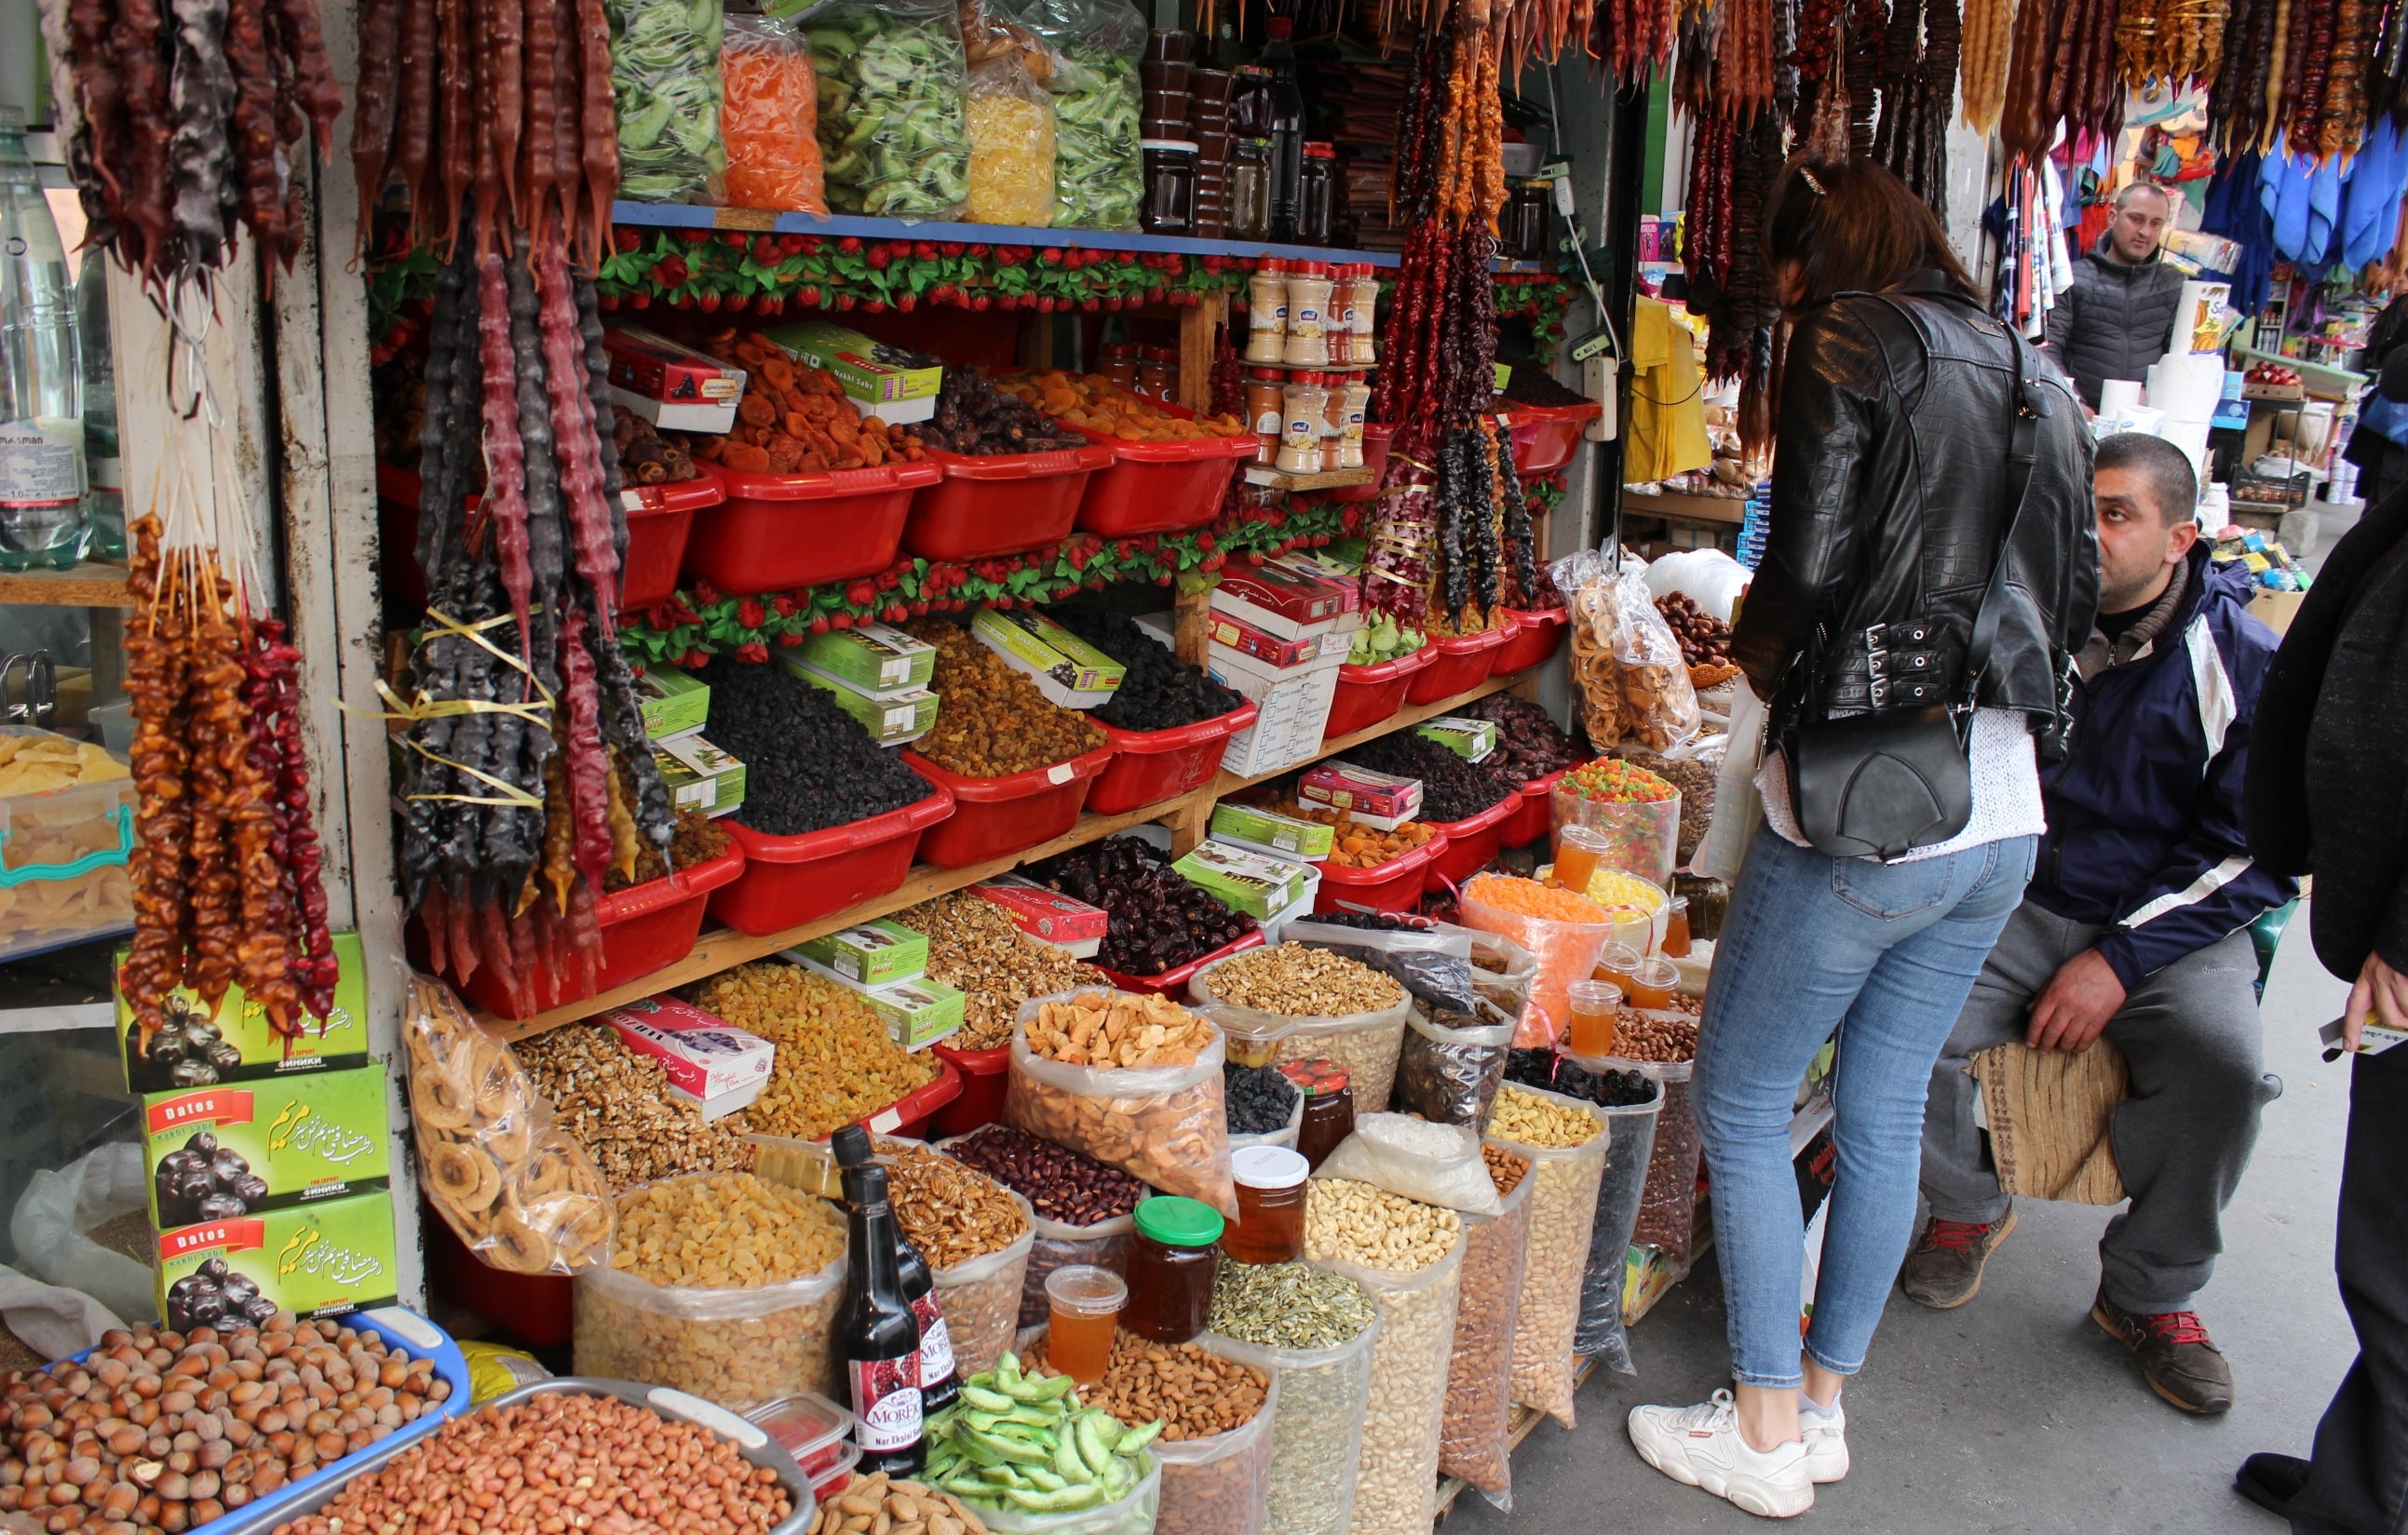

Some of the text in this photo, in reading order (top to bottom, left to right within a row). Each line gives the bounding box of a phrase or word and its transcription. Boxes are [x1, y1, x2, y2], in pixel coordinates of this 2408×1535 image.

[164, 1098, 214, 1121] Dates
[303, 1182, 345, 1197] ФИНИКИ
[176, 1227, 226, 1248] Dates
[313, 1302, 355, 1316] ФИНИКИ
[875, 1436, 890, 1447] Nar
